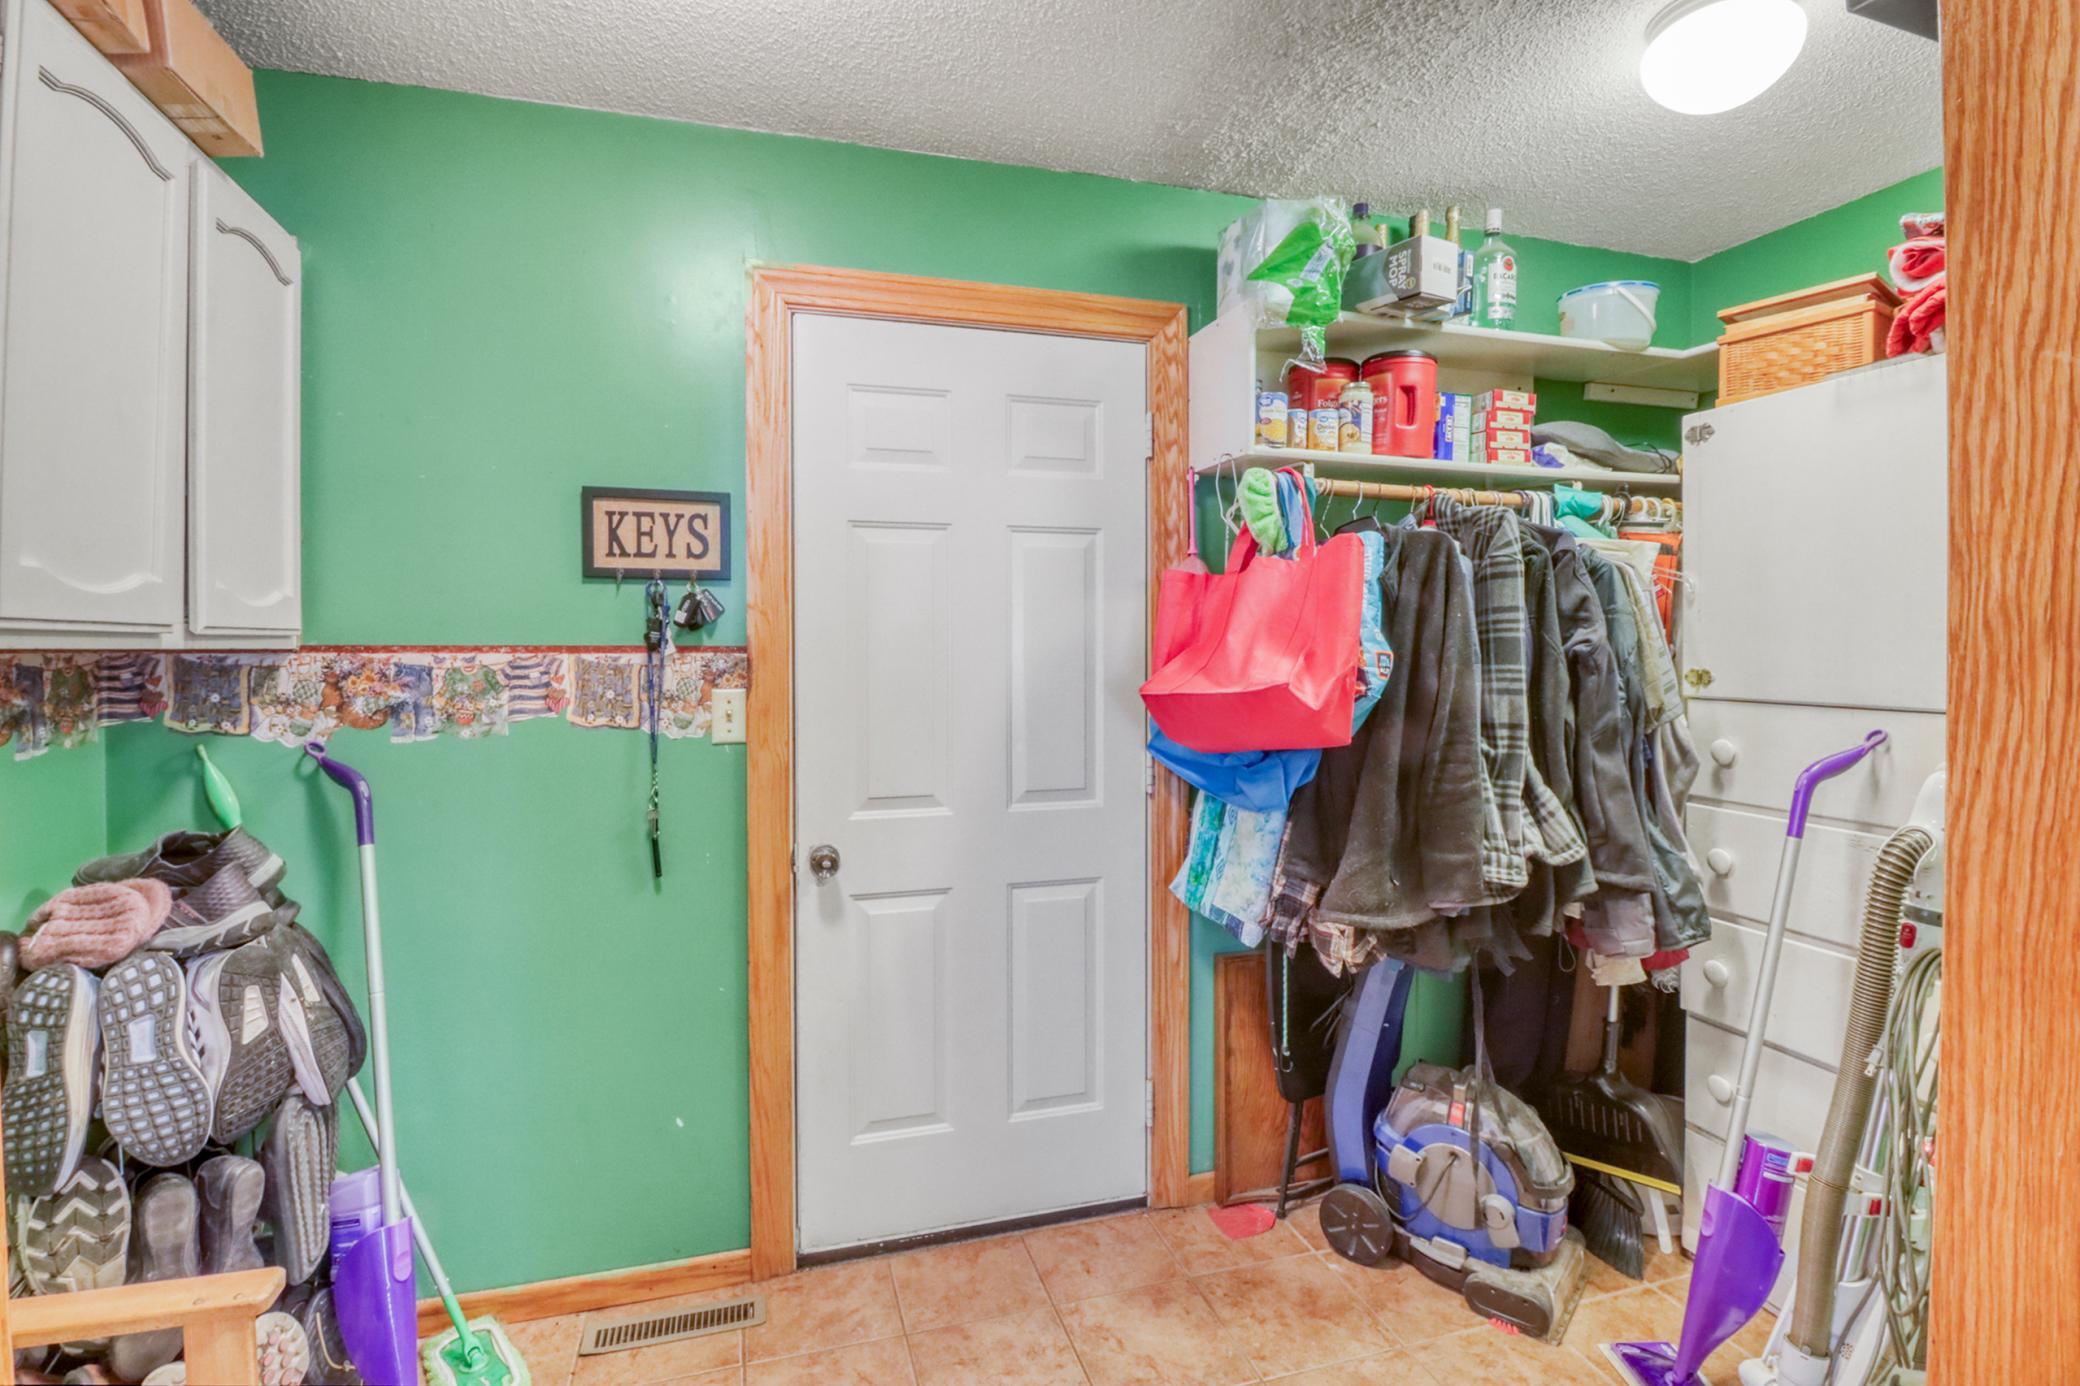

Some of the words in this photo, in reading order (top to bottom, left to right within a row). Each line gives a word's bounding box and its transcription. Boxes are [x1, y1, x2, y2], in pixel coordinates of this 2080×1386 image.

[1388, 254, 1398, 287] MOP
[1398, 250, 1407, 289] SPRAY
[605, 510, 709, 560] KEYS
